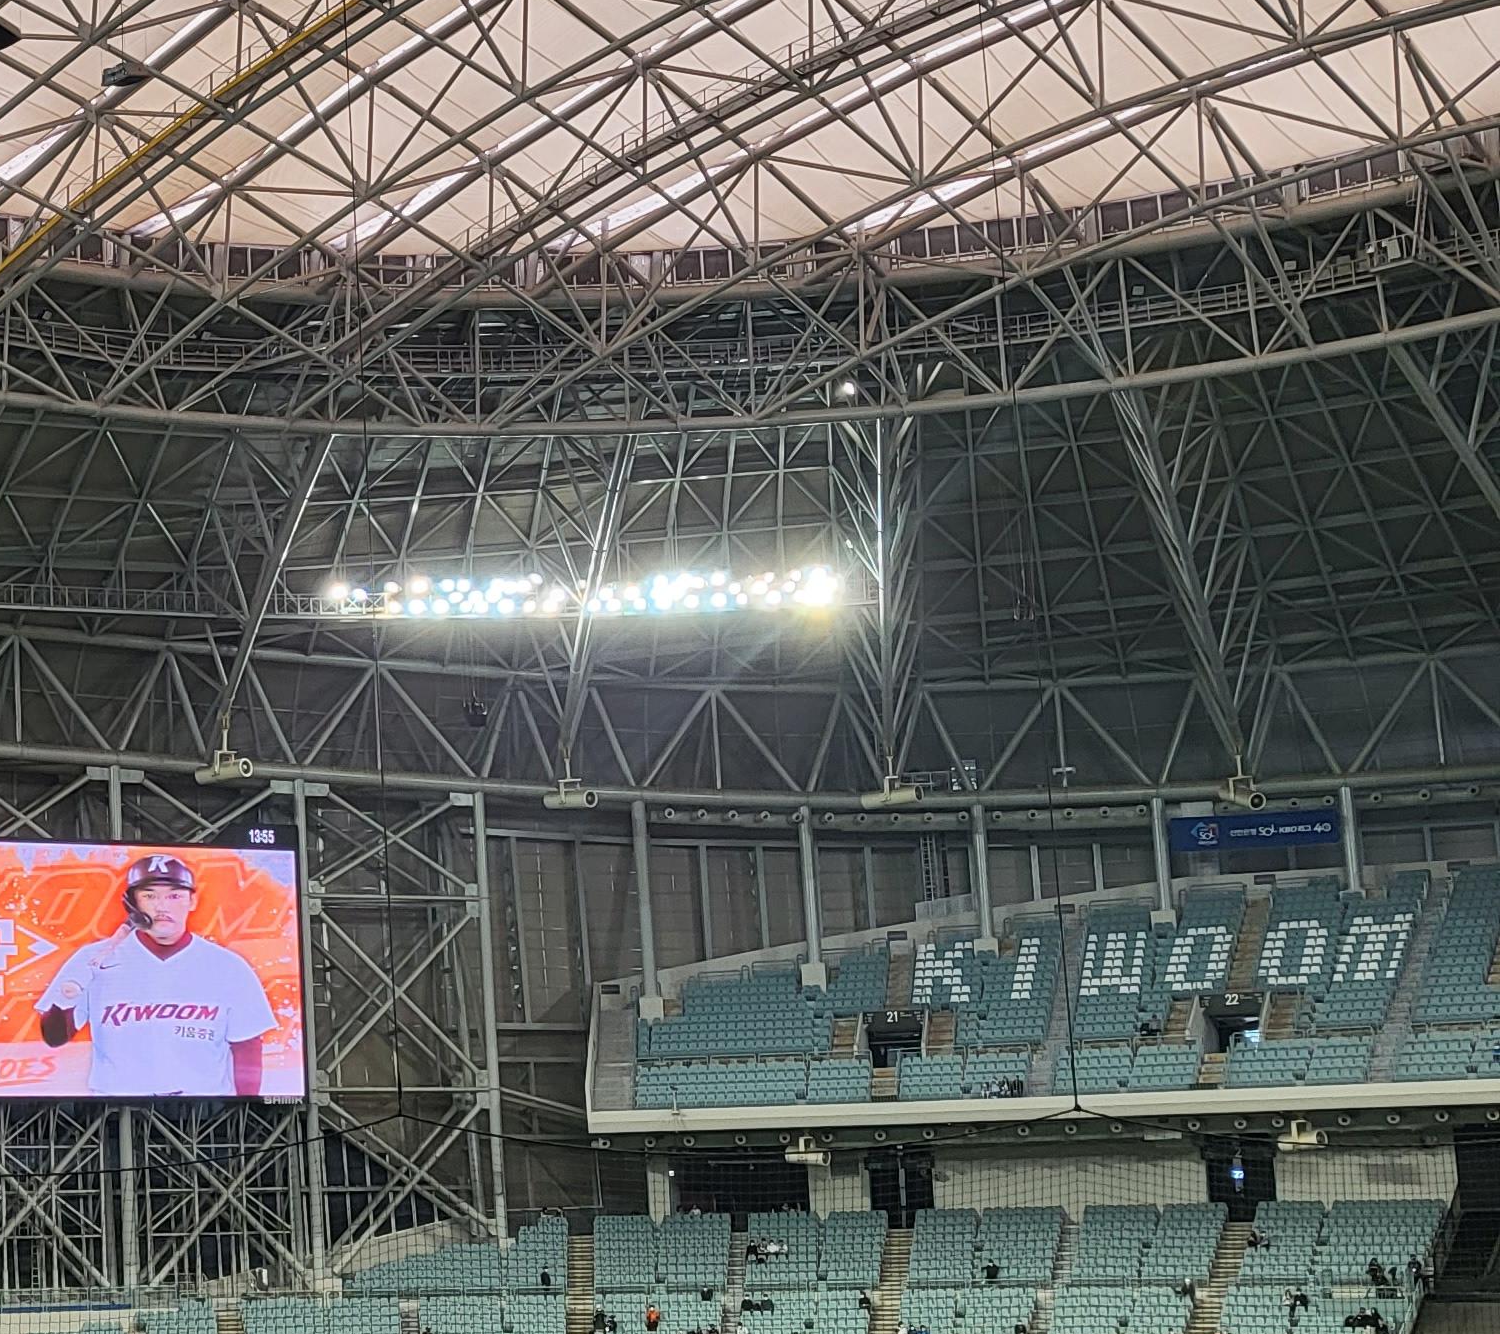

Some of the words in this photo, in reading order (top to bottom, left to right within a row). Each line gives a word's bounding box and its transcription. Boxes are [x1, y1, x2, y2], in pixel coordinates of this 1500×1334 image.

[249, 828, 275, 844] 13:55
[911, 913, 1416, 1005] KIWOOM
[1224, 993, 1240, 1006] 22
[101, 1003, 220, 1027] KIWOOM
[886, 1011, 898, 1023] 21
